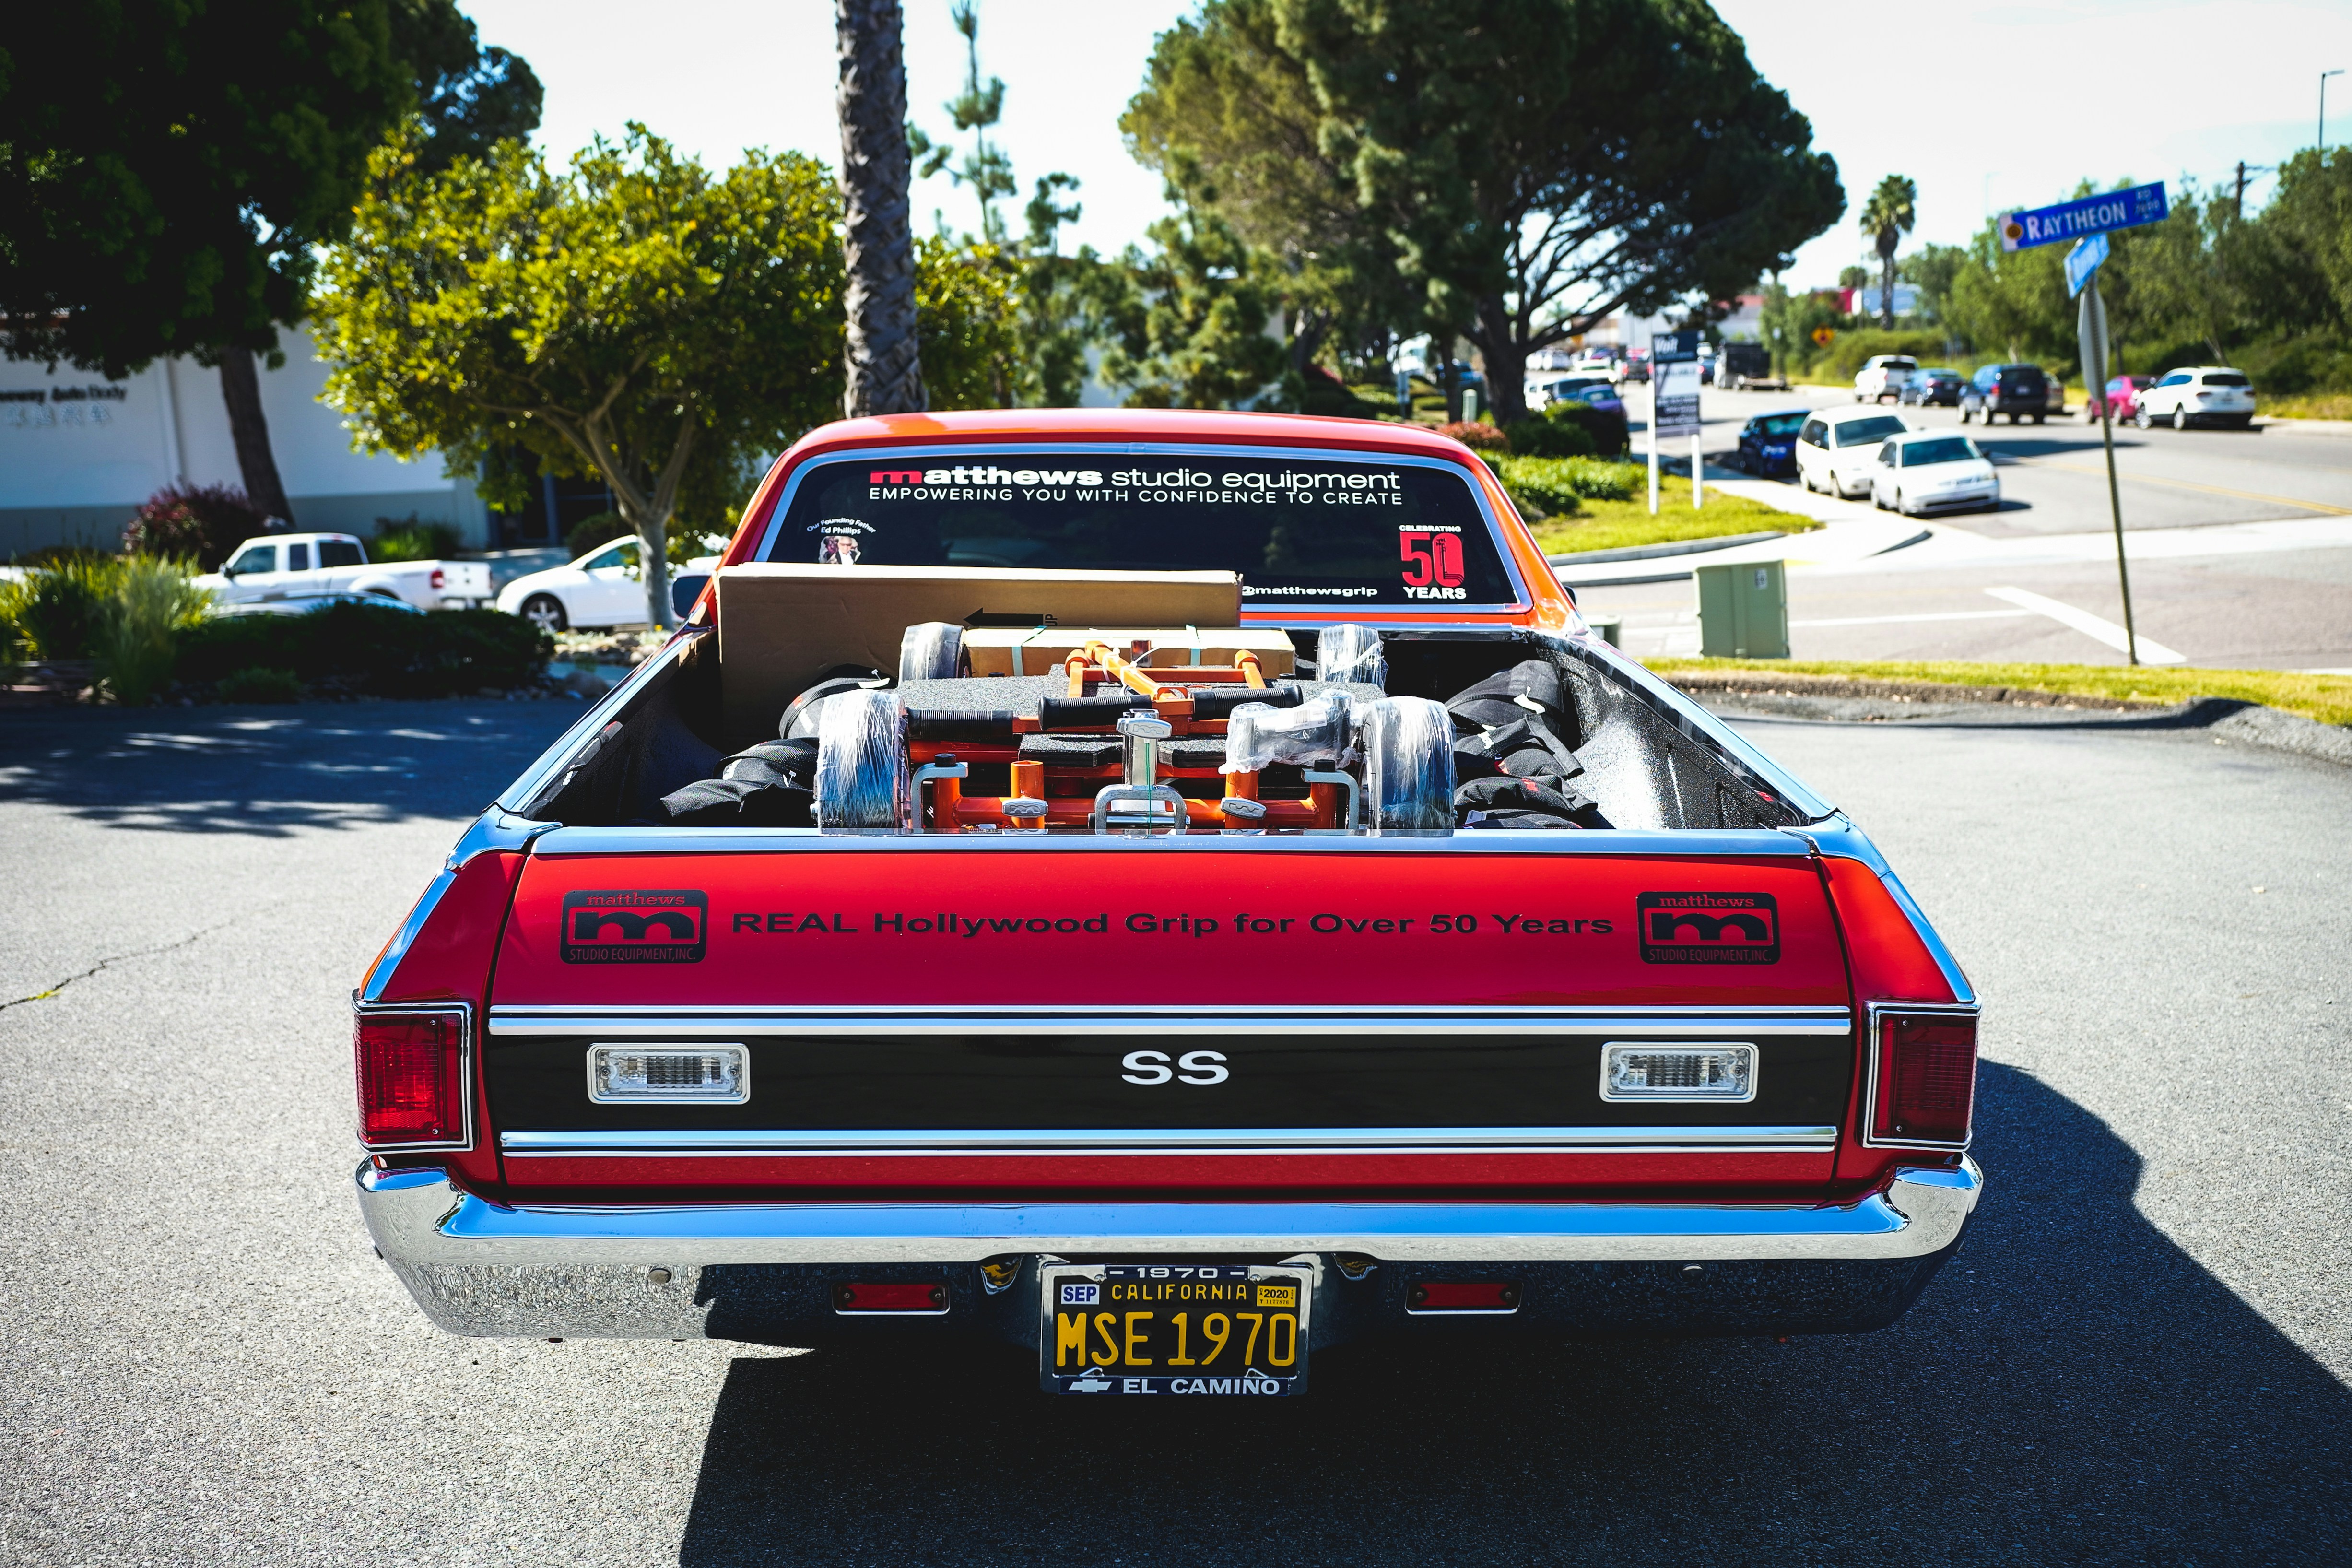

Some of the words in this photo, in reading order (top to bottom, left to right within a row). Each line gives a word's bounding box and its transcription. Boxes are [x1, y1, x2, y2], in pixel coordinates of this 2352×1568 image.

[2026, 199, 2126, 241] RAYTHEON
[870, 466, 1103, 485] matthews
[1111, 468, 1212, 487] studio
[1222, 470, 1401, 492] equipment
[869, 487, 1013, 501] EMPOWERING
[1023, 488, 1066, 502] YOU
[1076, 489, 1128, 502] WITH
[1138, 490, 1276, 503] CONFIDENCE
[1286, 492, 1313, 504] TO
[1323, 492, 1402, 505] CREATE
[807, 522, 820, 532] Our
[820, 517, 855, 526] Founding
[855, 519, 877, 533] Father
[832, 526, 862, 536] Phillips
[1399, 531, 1465, 588] 50
[1241, 586, 1378, 597] @matthewsgrip
[1402, 587, 1467, 600] YEARS
[1045, 613, 1058, 626] UP
[586, 892, 685, 906] matthews
[1659, 894, 1755, 908] matthews
[732, 913, 858, 933] REAL
[873, 913, 1108, 938] Hollywood
[1125, 913, 1219, 938] Grip
[1233, 913, 1295, 933] for
[1309, 913, 1415, 934] Over
[1430, 914, 1478, 934] 50
[1491, 914, 1614, 934] Years
[570, 948, 608, 960] STUDIO
[1649, 949, 1687, 960] STUDIO
[1121, 1050, 1229, 1085] SS
[1137, 1267, 1218, 1278] 1970
[1063, 1286, 1097, 1302] SEP
[1112, 1284, 1247, 1300] CALIFORNIA
[1264, 1289, 1289, 1299] 2020
[1123, 1379, 1157, 1394] EL
[1171, 1379, 1280, 1395] CAMINO
